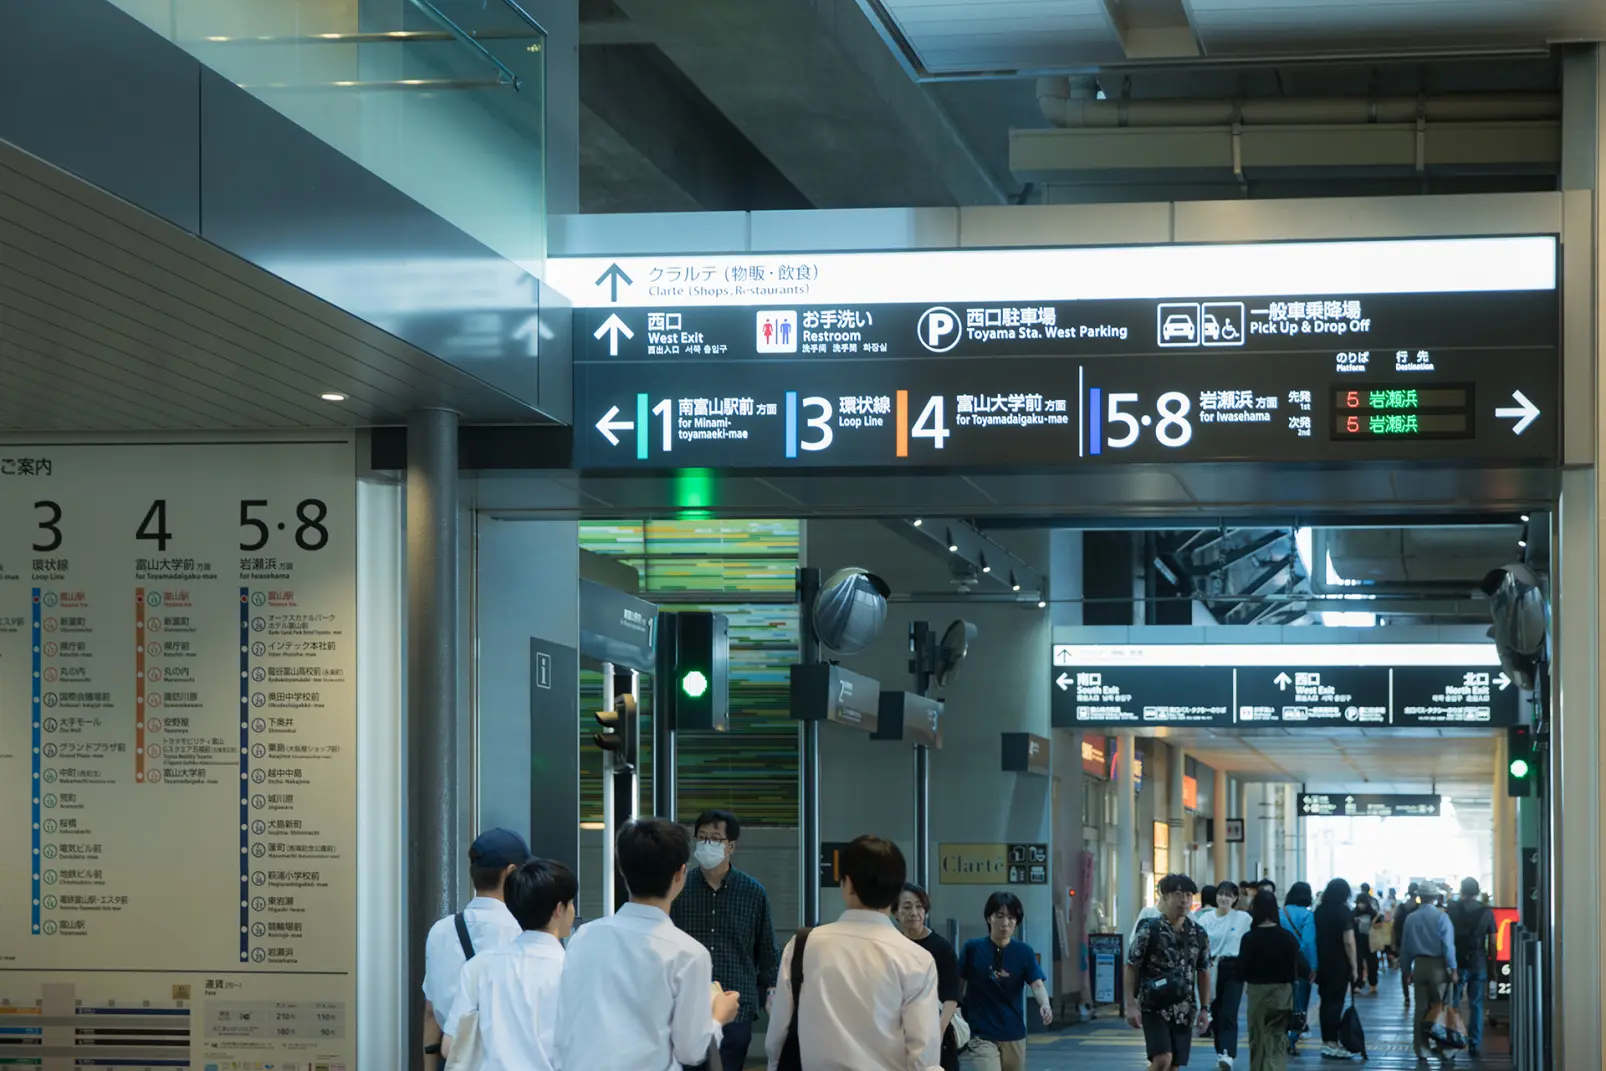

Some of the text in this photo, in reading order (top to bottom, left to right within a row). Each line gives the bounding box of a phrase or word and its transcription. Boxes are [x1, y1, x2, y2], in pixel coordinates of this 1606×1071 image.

[966, 307, 1056, 326] 西口駐車場
[1250, 300, 1361, 320] 一般車乗降場
[648, 312, 682, 330] 西口
[802, 309, 873, 328] お手洗い
[967, 325, 1128, 341] Toyama Sta. West Parking
[1250, 319, 1371, 336] Pick Up & Drop Off
[648, 332, 704, 345] West Exit
[802, 330, 861, 342] Restroom
[1336, 351, 1370, 363] のりば
[1336, 363, 1366, 372] Platform
[1396, 362, 1434, 371] Destination
[956, 394, 1067, 413] 富山大学前 方面
[1199, 390, 1278, 409] 岩瀬浜 方面
[1288, 391, 1311, 403] 先発
[1347, 390, 1418, 409] 5 岩瀬浜
[678, 398, 777, 416] 南富山駅前 方面
[839, 395, 891, 414] 環状線
[678, 417, 732, 428] for Minami-
[800, 396, 833, 451] 3
[839, 416, 883, 429] Loop Line
[911, 396, 950, 449] 4
[956, 414, 1069, 427] for Toyamadaigaku-mae
[1200, 411, 1270, 423] for Iwasehama
[1288, 416, 1311, 429] 次発
[652, 398, 672, 452] 1
[1347, 415, 1418, 433] 5 岩瀬浜
[678, 428, 749, 442] toyamaeki-mae
[1298, 428, 1311, 436] 2nd
[1, 457, 52, 476] ご案内
[32, 500, 63, 552] 3
[135, 499, 173, 551] 4
[32, 558, 69, 572] 環状線
[135, 558, 195, 571] 富山大学前
[240, 557, 277, 571] 岩瀬浜
[32, 572, 65, 582] Loop Line
[147, 573, 218, 582] Toyamadaigaku-mae
[240, 572, 290, 580] for Iwasehama
[648, 617, 653, 647] 1
[268, 641, 336, 651] インテック本社前
[1295, 672, 1320, 685] 西口
[1463, 672, 1489, 686] 北口
[1077, 685, 1120, 695] South Exit
[1295, 686, 1335, 695] West Exit
[1445, 686, 1490, 695] North Exit
[268, 692, 320, 702] 奥田中学校前
[59, 718, 102, 727] 大手モール
[268, 717, 294, 727] 下奥井
[59, 742, 127, 752] グランドプラザ前
[268, 768, 303, 778] 越中中島
